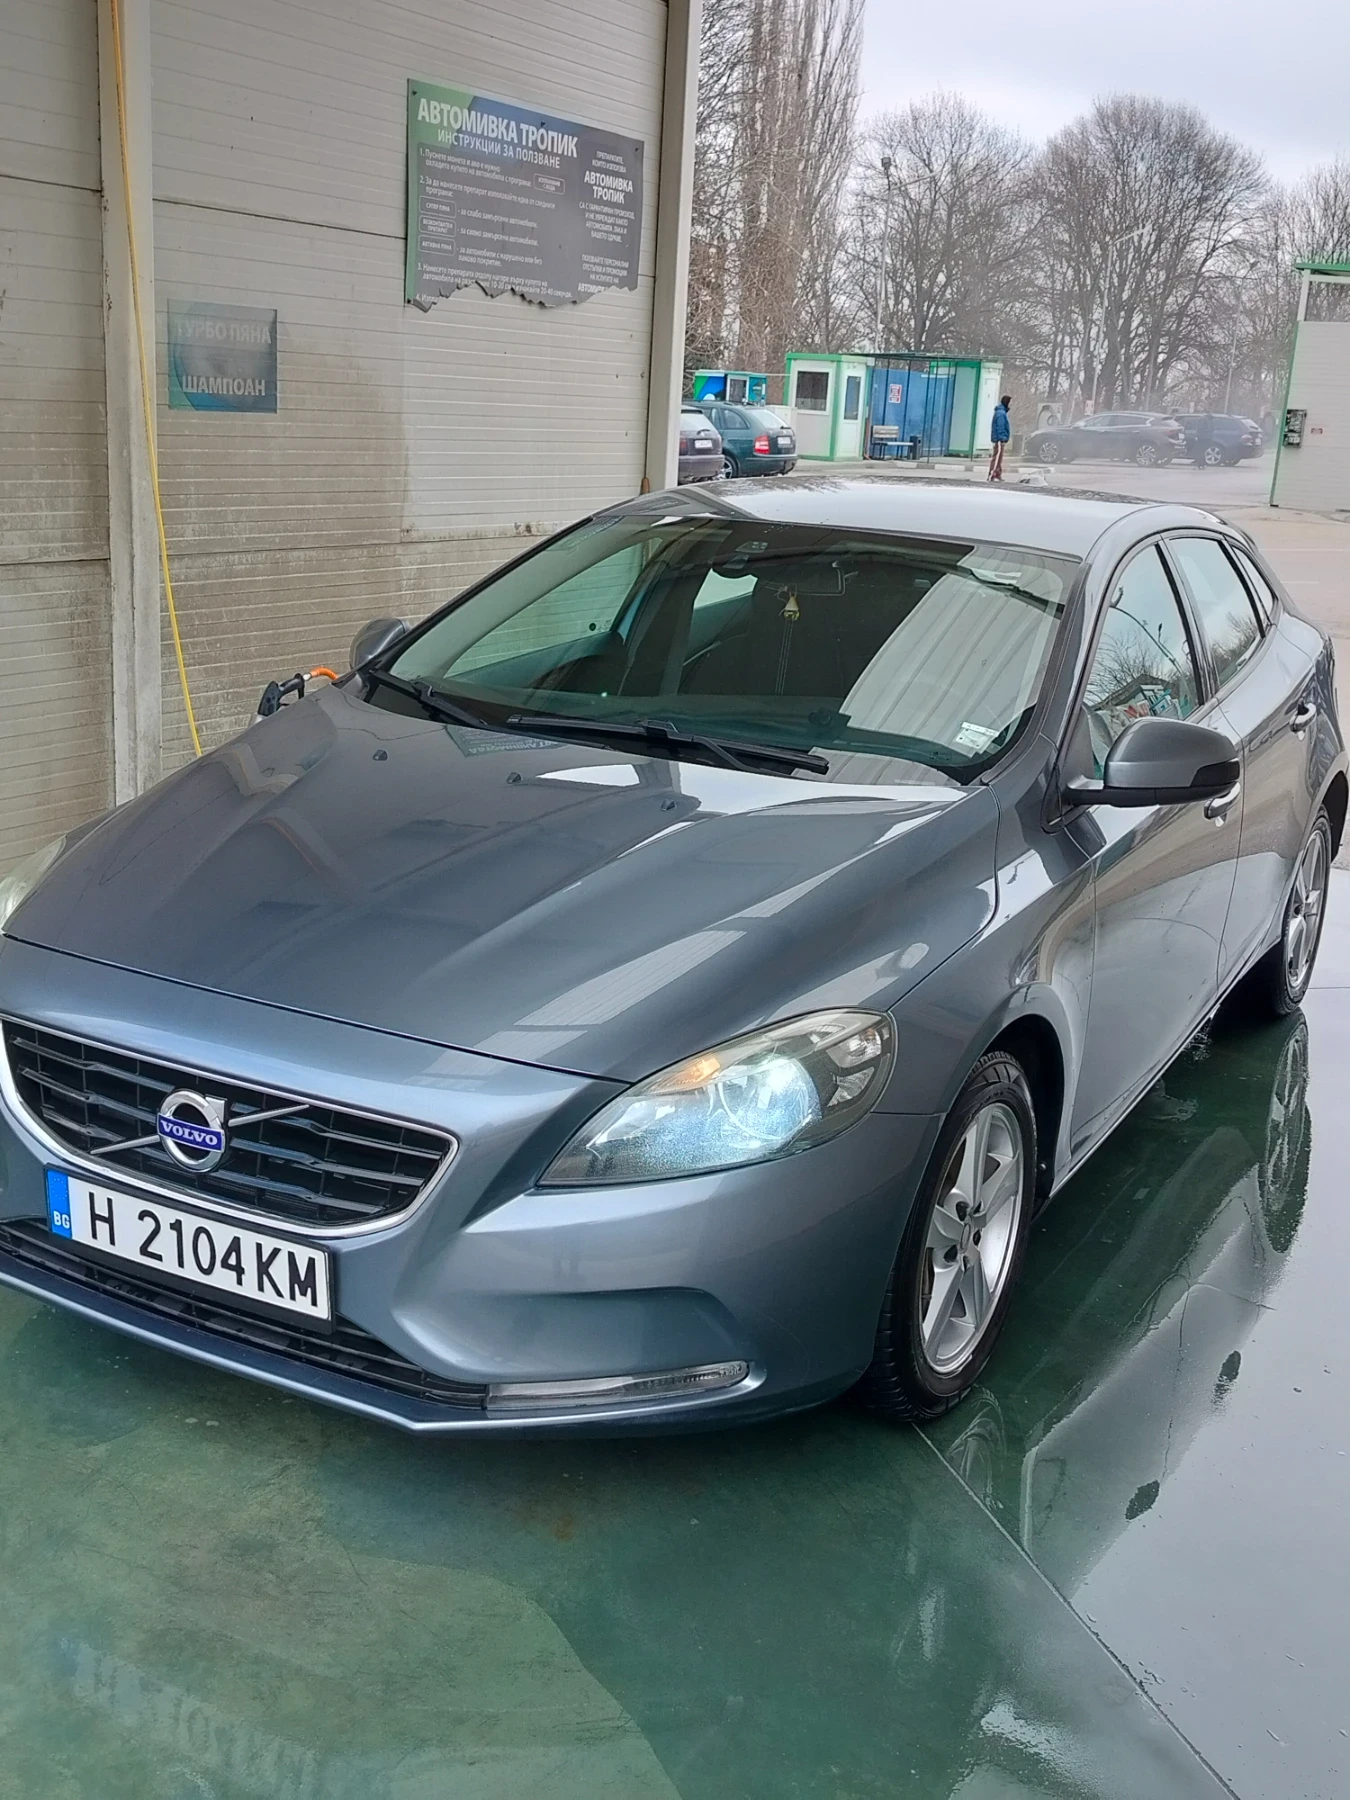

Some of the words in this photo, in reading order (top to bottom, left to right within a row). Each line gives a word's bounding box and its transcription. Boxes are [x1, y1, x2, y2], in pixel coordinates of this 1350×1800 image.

[417, 98, 518, 144] АВТОМИВКА
[519, 123, 578, 158] ТРОПИК
[438, 128, 501, 155] ИНСТРУКЦИИ
[503, 144, 514, 158] ЗА
[515, 148, 560, 169] ПОЛЗВАНЕ
[592, 159, 606, 169] КОИТО
[584, 170, 633, 193] АВТОМИВКА
[592, 186, 625, 205] ТРОПИК
[467, 209, 482, 218] слабо
[176, 319, 227, 340] ТУРБО
[229, 323, 272, 344] ПЯНА
[182, 375, 266, 396] ШАМПОАН
[160, 1119, 218, 1146] VOLVO
[53, 1210, 71, 1229] BG
[88, 1191, 116, 1247] H
